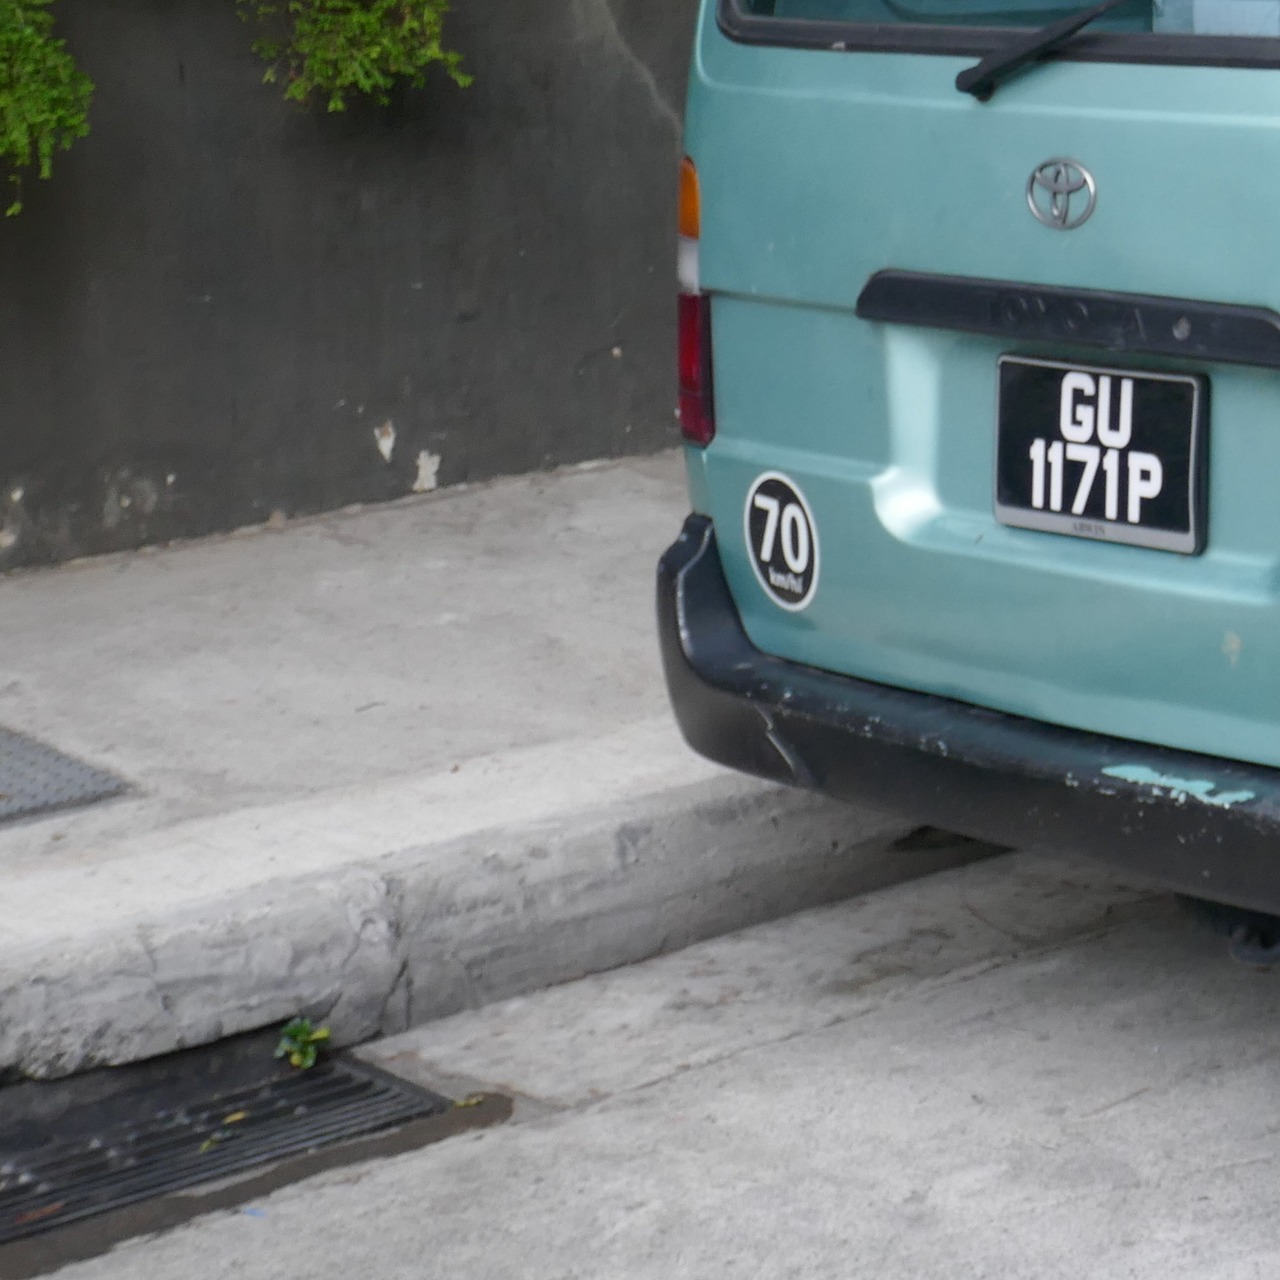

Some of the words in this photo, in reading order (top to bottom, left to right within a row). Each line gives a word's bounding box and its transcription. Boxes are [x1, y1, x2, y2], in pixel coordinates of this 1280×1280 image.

[1060, 371, 1133, 449] GU
[1029, 437, 1163, 524] 1171P
[754, 493, 810, 574] 70
